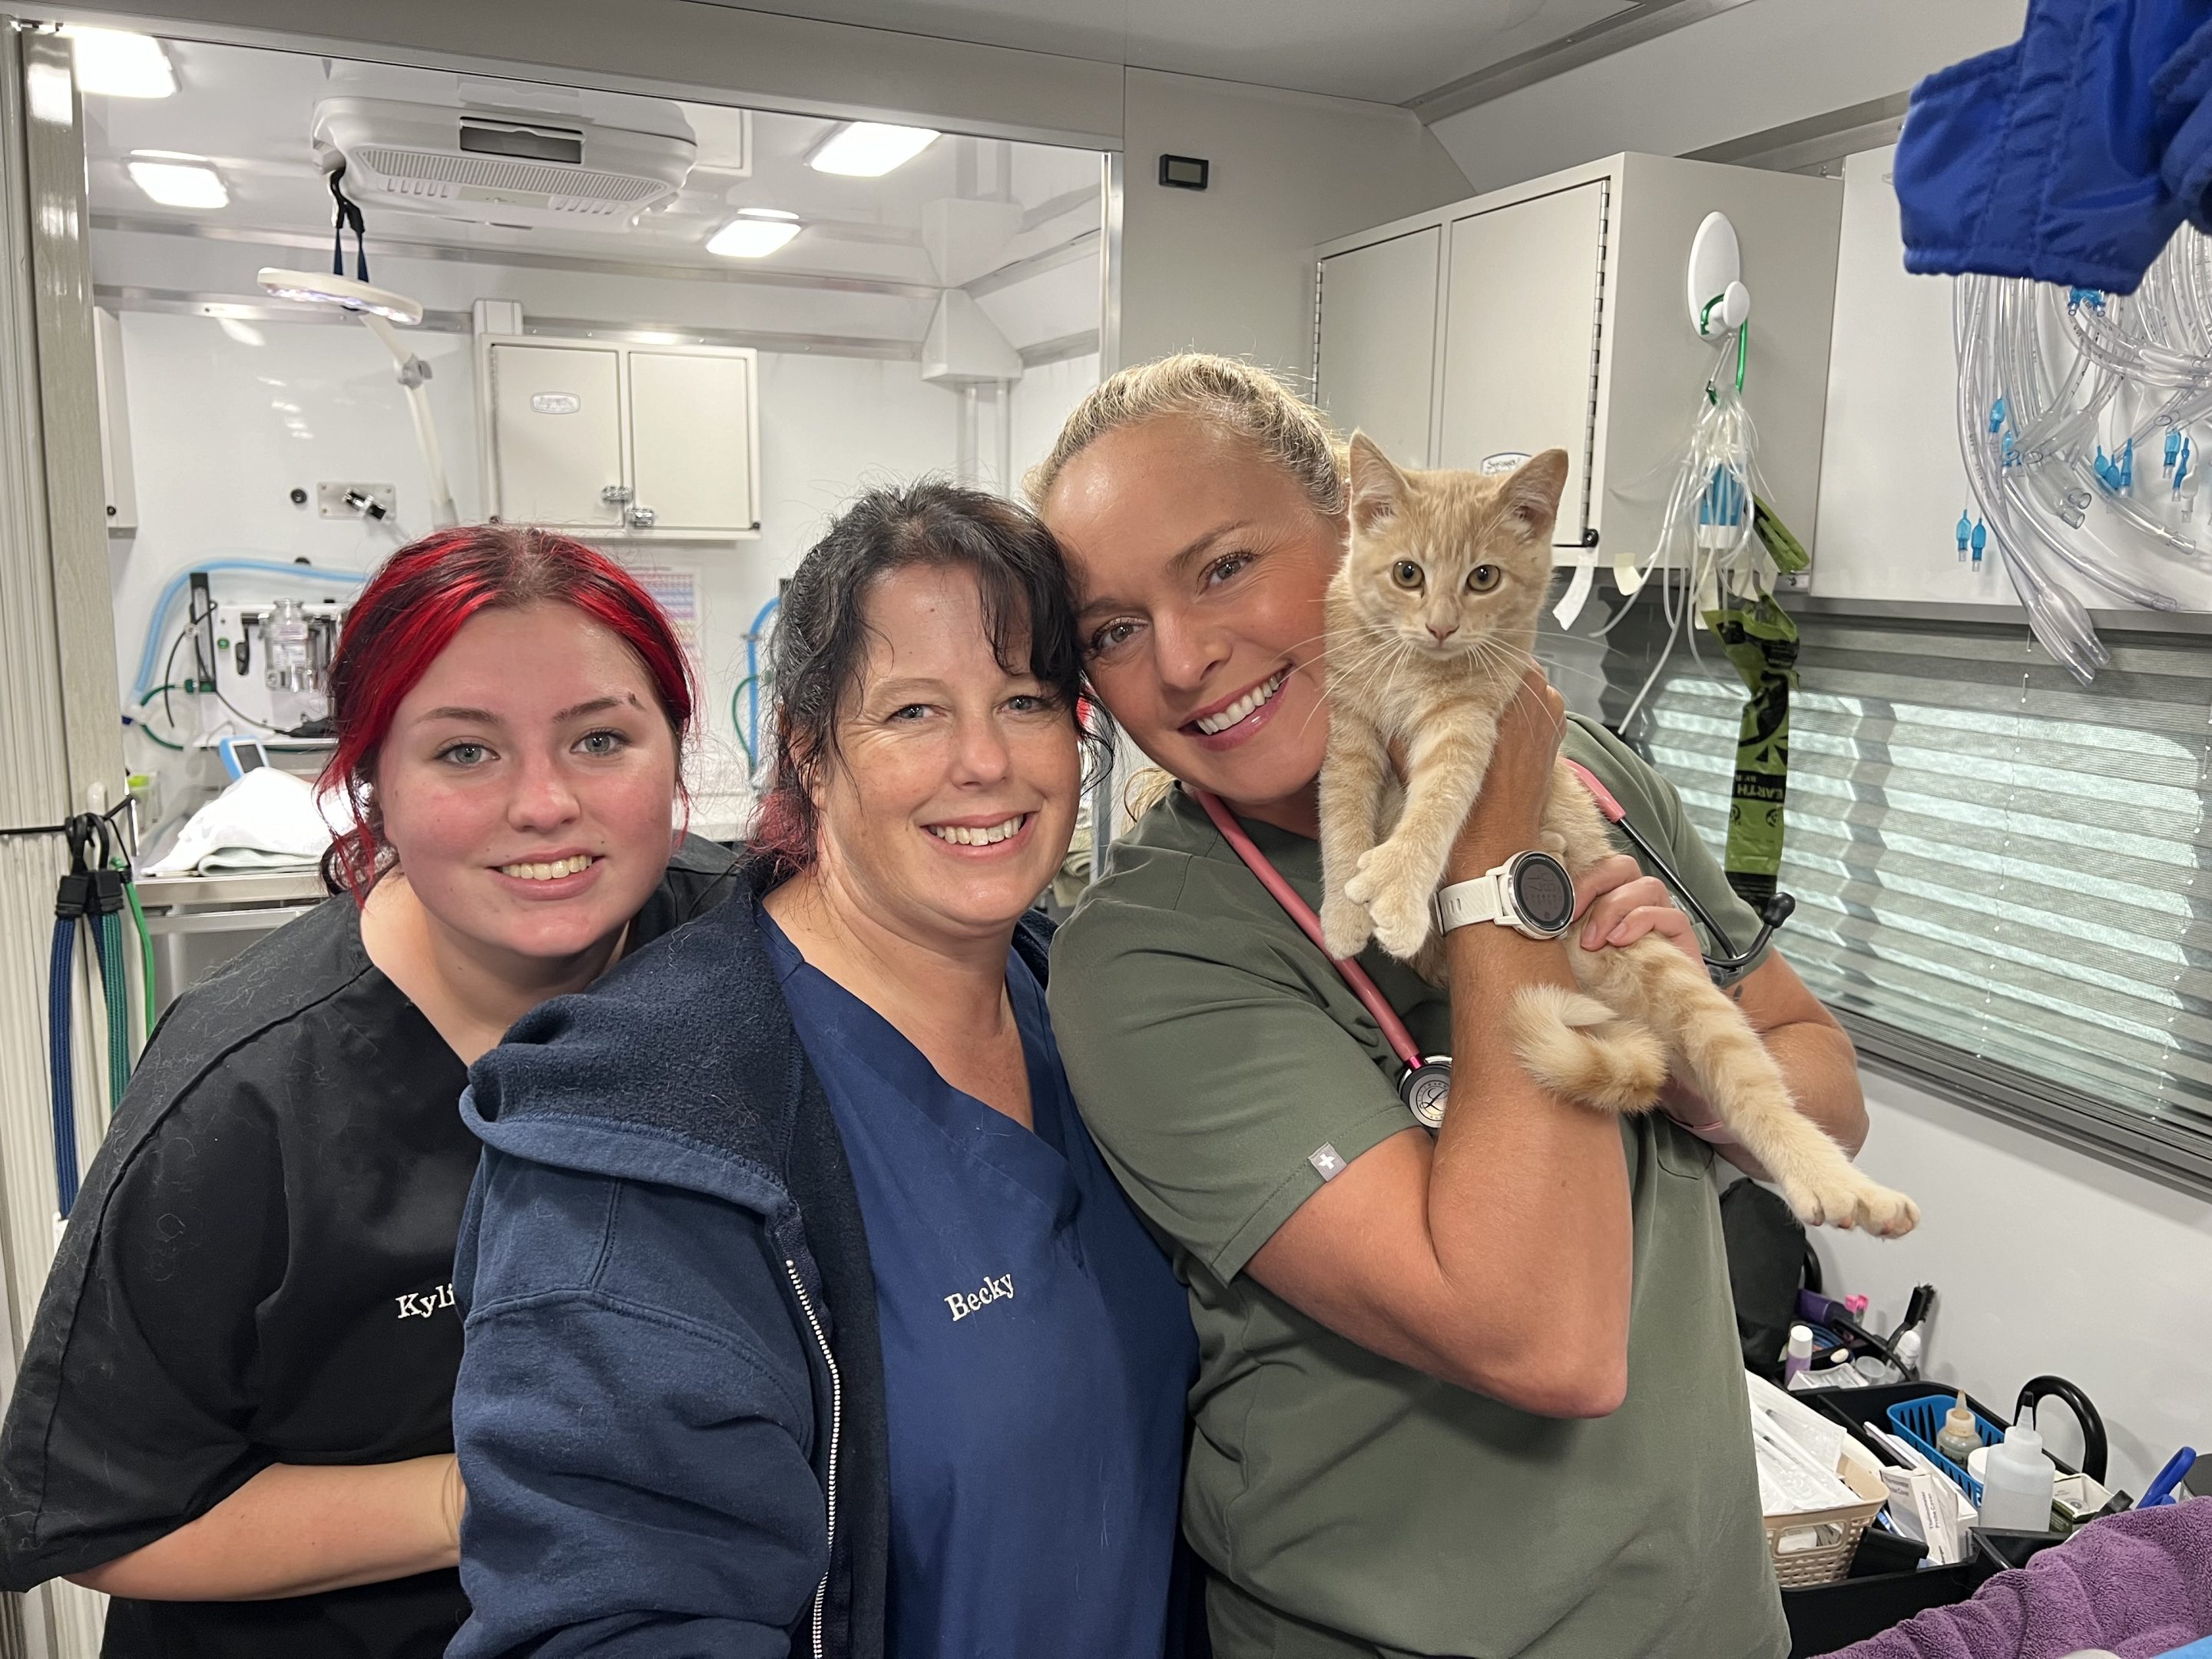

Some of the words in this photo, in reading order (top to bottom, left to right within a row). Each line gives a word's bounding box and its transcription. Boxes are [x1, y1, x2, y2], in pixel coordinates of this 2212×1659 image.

[1737, 784, 1783, 800] EARTH
[396, 1283, 455, 1319] Kyli
[944, 1274, 1014, 1322] Becky
